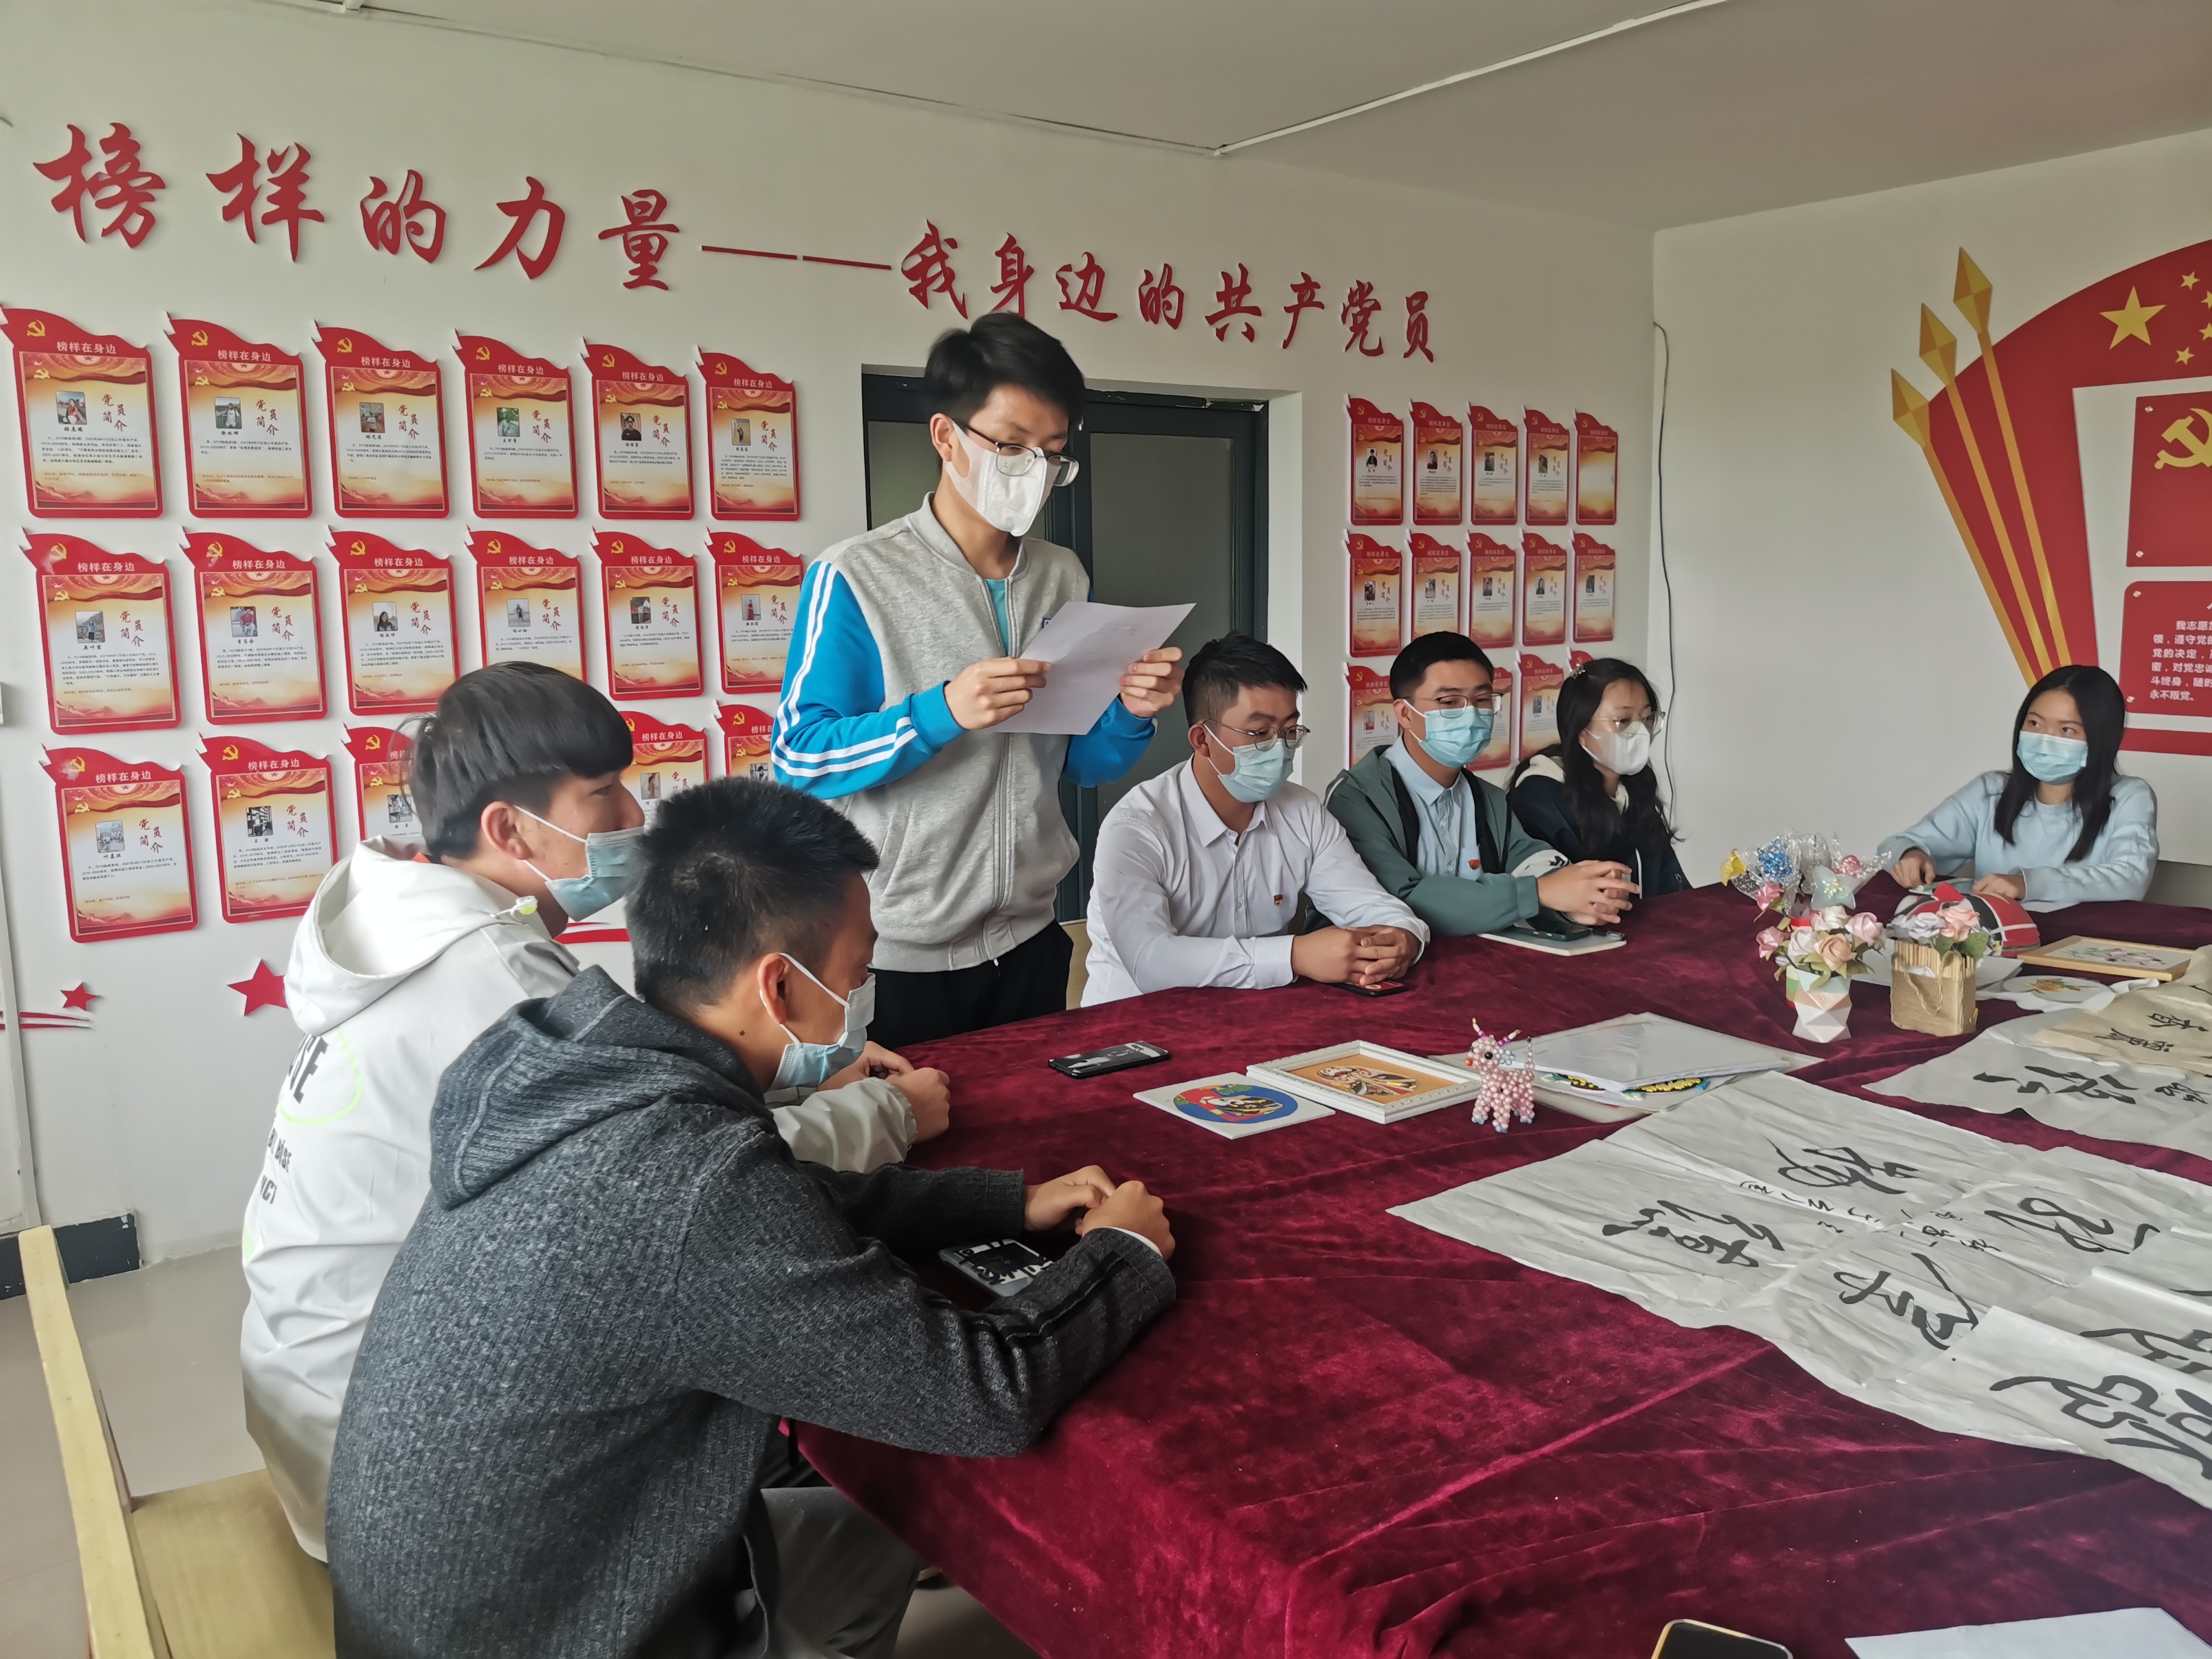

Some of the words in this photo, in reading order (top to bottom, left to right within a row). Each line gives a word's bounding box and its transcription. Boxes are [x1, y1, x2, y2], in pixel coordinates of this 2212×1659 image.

[56, 341, 117, 354] 榜样在身边
[217, 349, 272, 362] 榜样在身边
[361, 356, 411, 368] 榜样在身边
[498, 363, 544, 375] 榜样在身边
[622, 371, 664, 382] 榜样在身边
[734, 378, 773, 389] 榜样在身边
[232, 559, 285, 570] 榜样在身边
[374, 557, 424, 567] 榜样在身边
[509, 556, 554, 566] 榜样在身边
[631, 555, 673, 565] 榜样在身边
[742, 555, 781, 564] 榜样在身边
[77, 561, 135, 573] 榜样在身边
[642, 732, 684, 742] 榜样在身边
[247, 758, 300, 770] 榜样在身边
[95, 771, 152, 783] 榜样在身边
